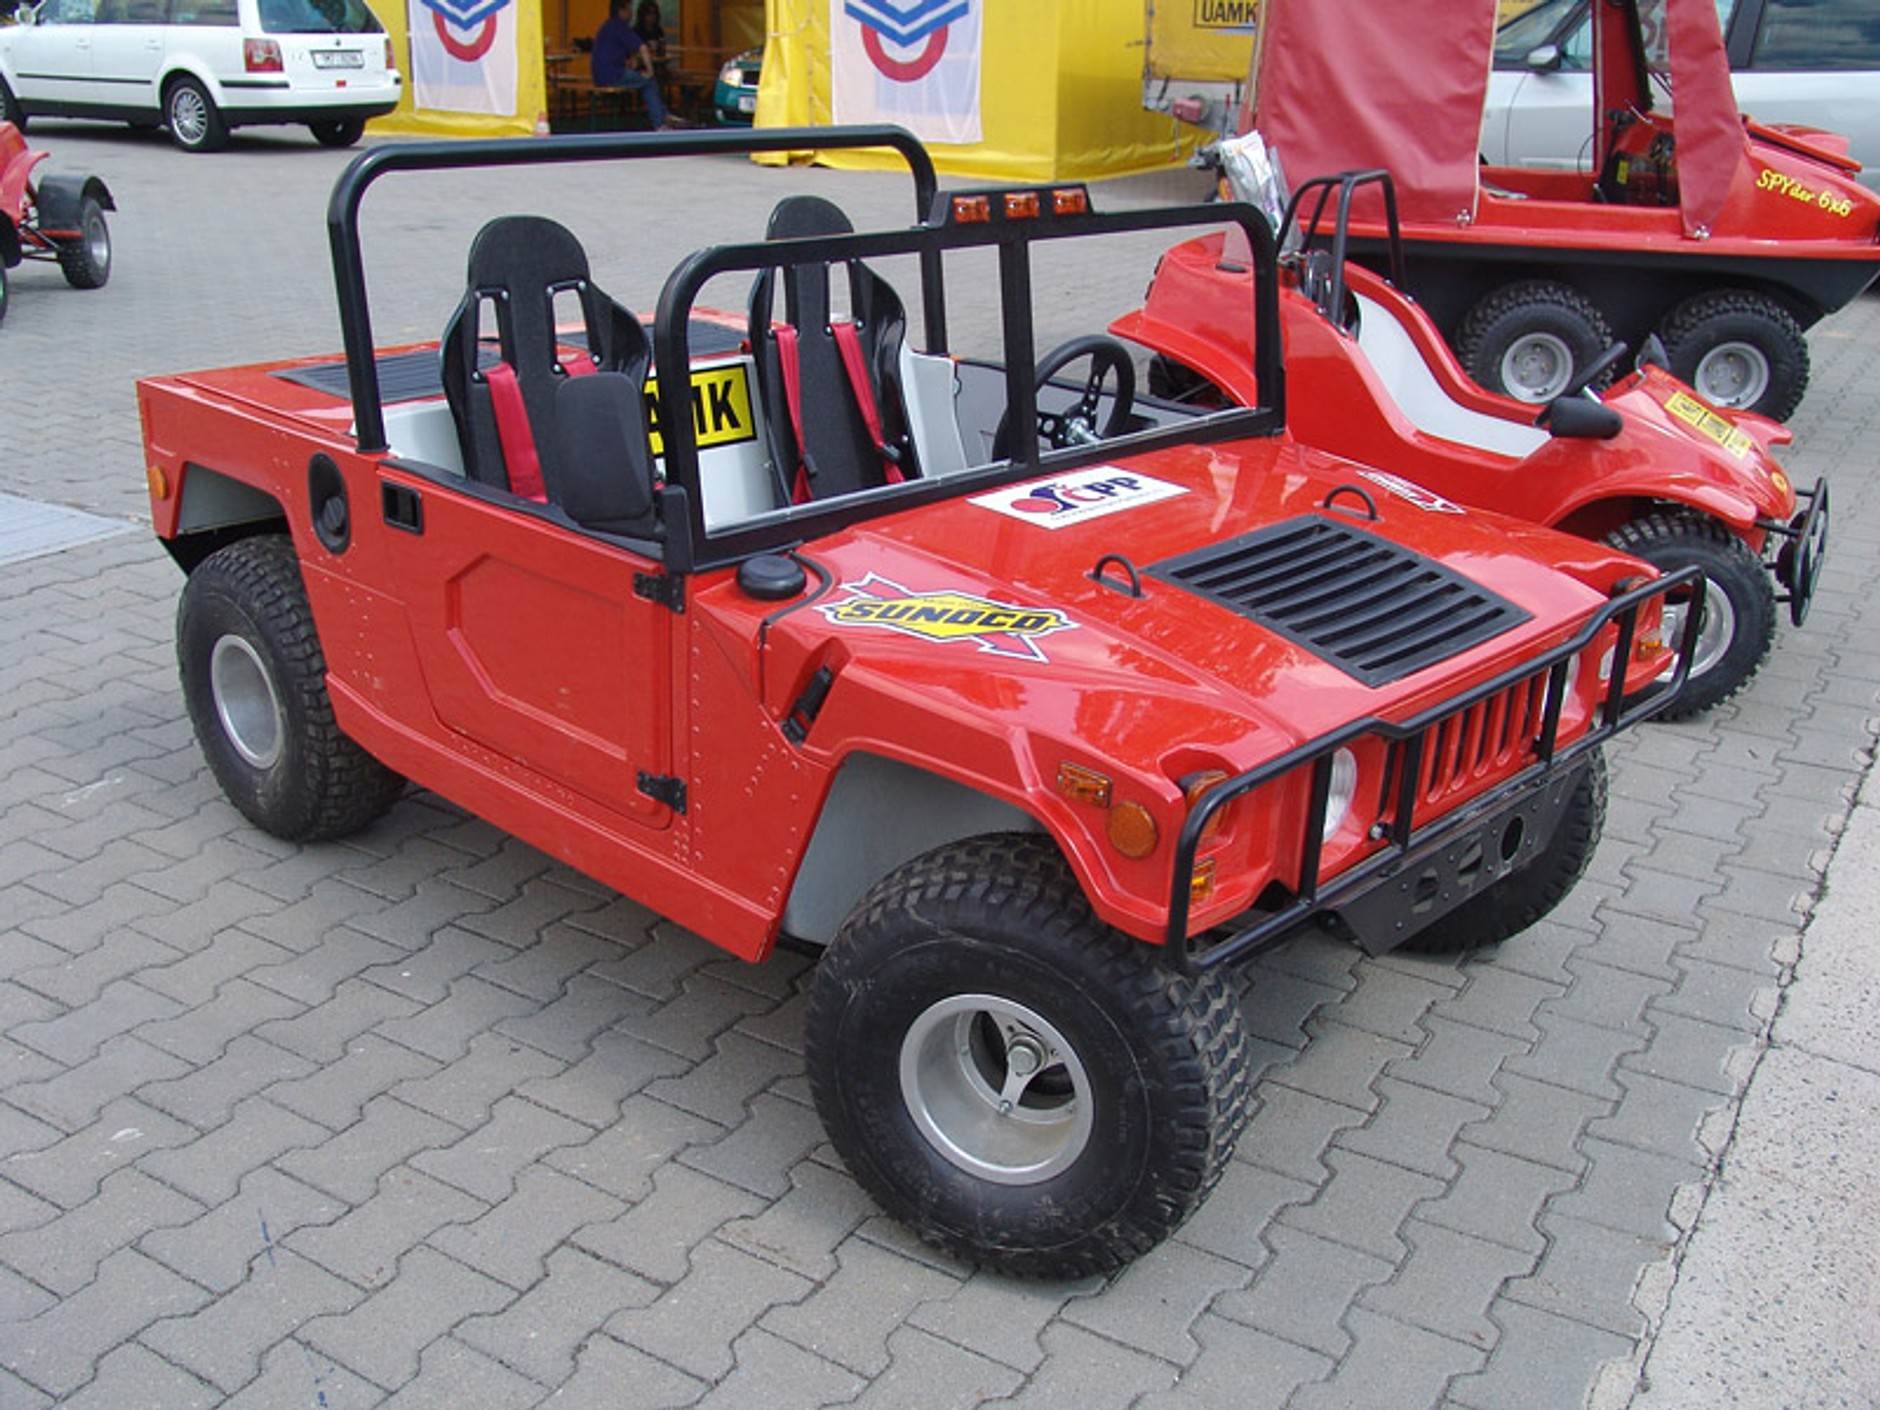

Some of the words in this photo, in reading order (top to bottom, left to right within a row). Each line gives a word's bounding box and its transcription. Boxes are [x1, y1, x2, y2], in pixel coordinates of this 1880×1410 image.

[1755, 169, 1815, 202] SPYder
[1818, 191, 1852, 217] 6x6
[846, 602, 1051, 630] SUNOCO
